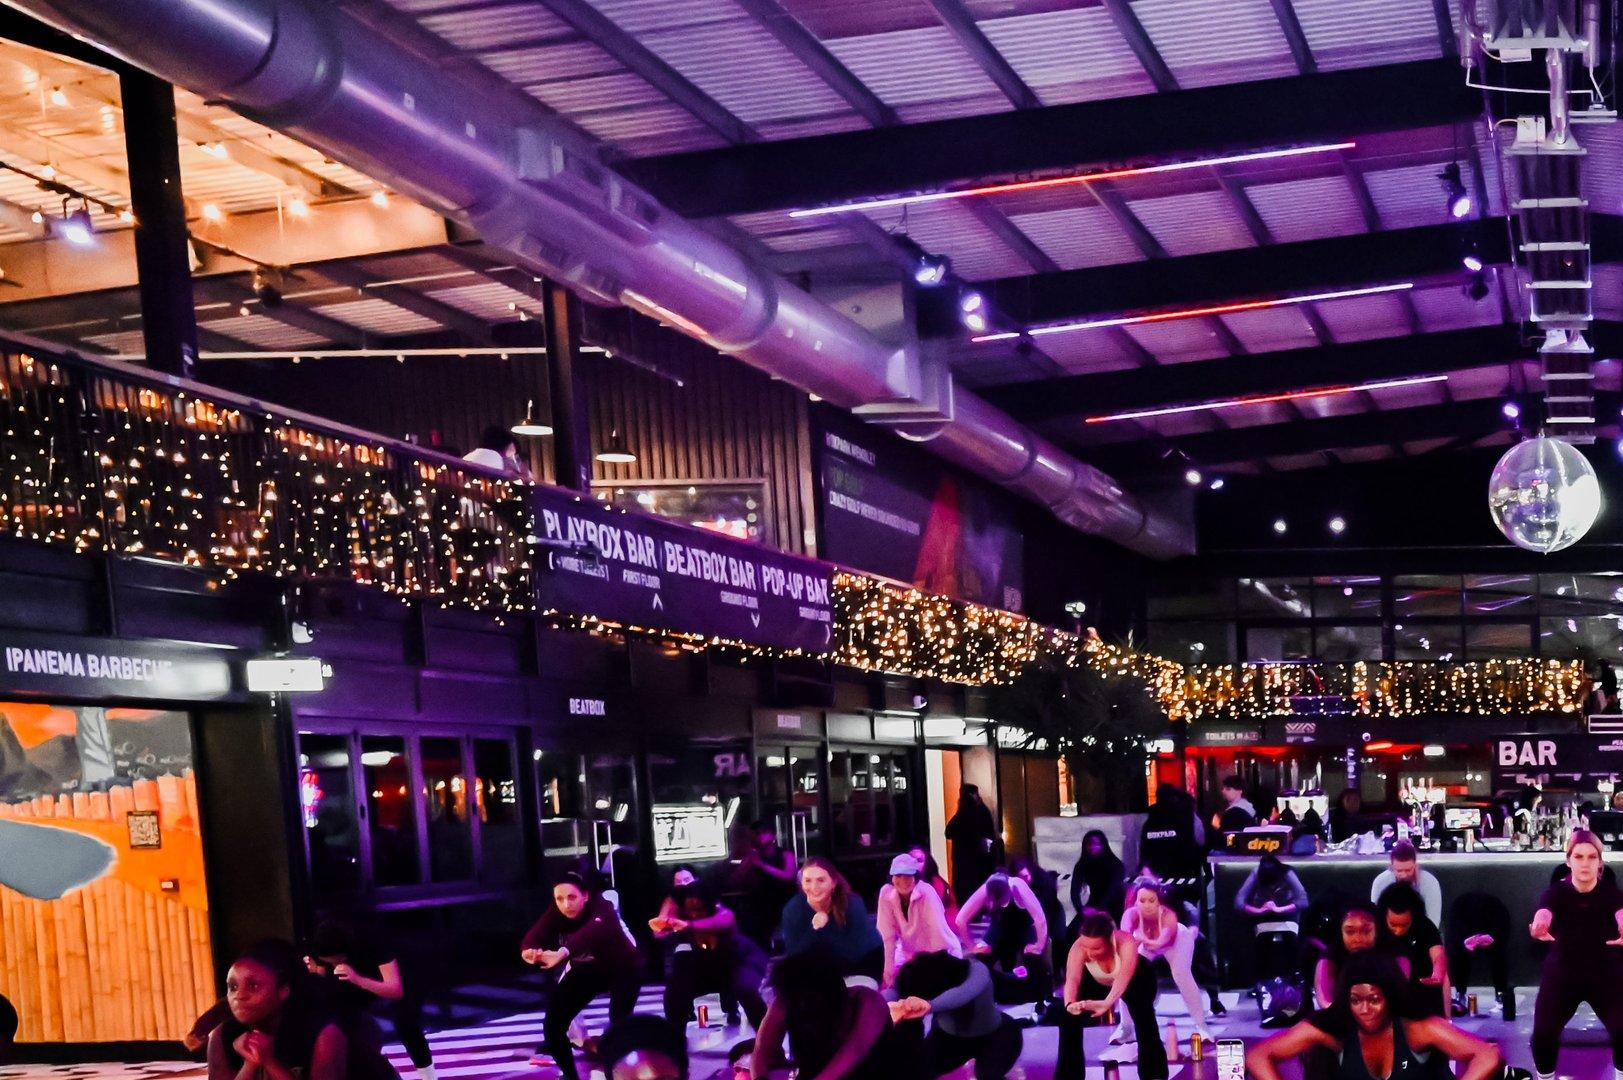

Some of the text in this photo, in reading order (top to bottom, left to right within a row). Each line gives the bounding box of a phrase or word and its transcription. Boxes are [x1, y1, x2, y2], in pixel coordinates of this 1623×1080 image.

[543, 509, 829, 605] PLAYBOX BAR BEATBOX BAR POP-UP BAR
[6, 647, 172, 683] IPANEMA BARBECU
[569, 698, 606, 716] BEATBOX
[1498, 740, 1558, 766] BAR
[1247, 837, 1281, 852] drip
